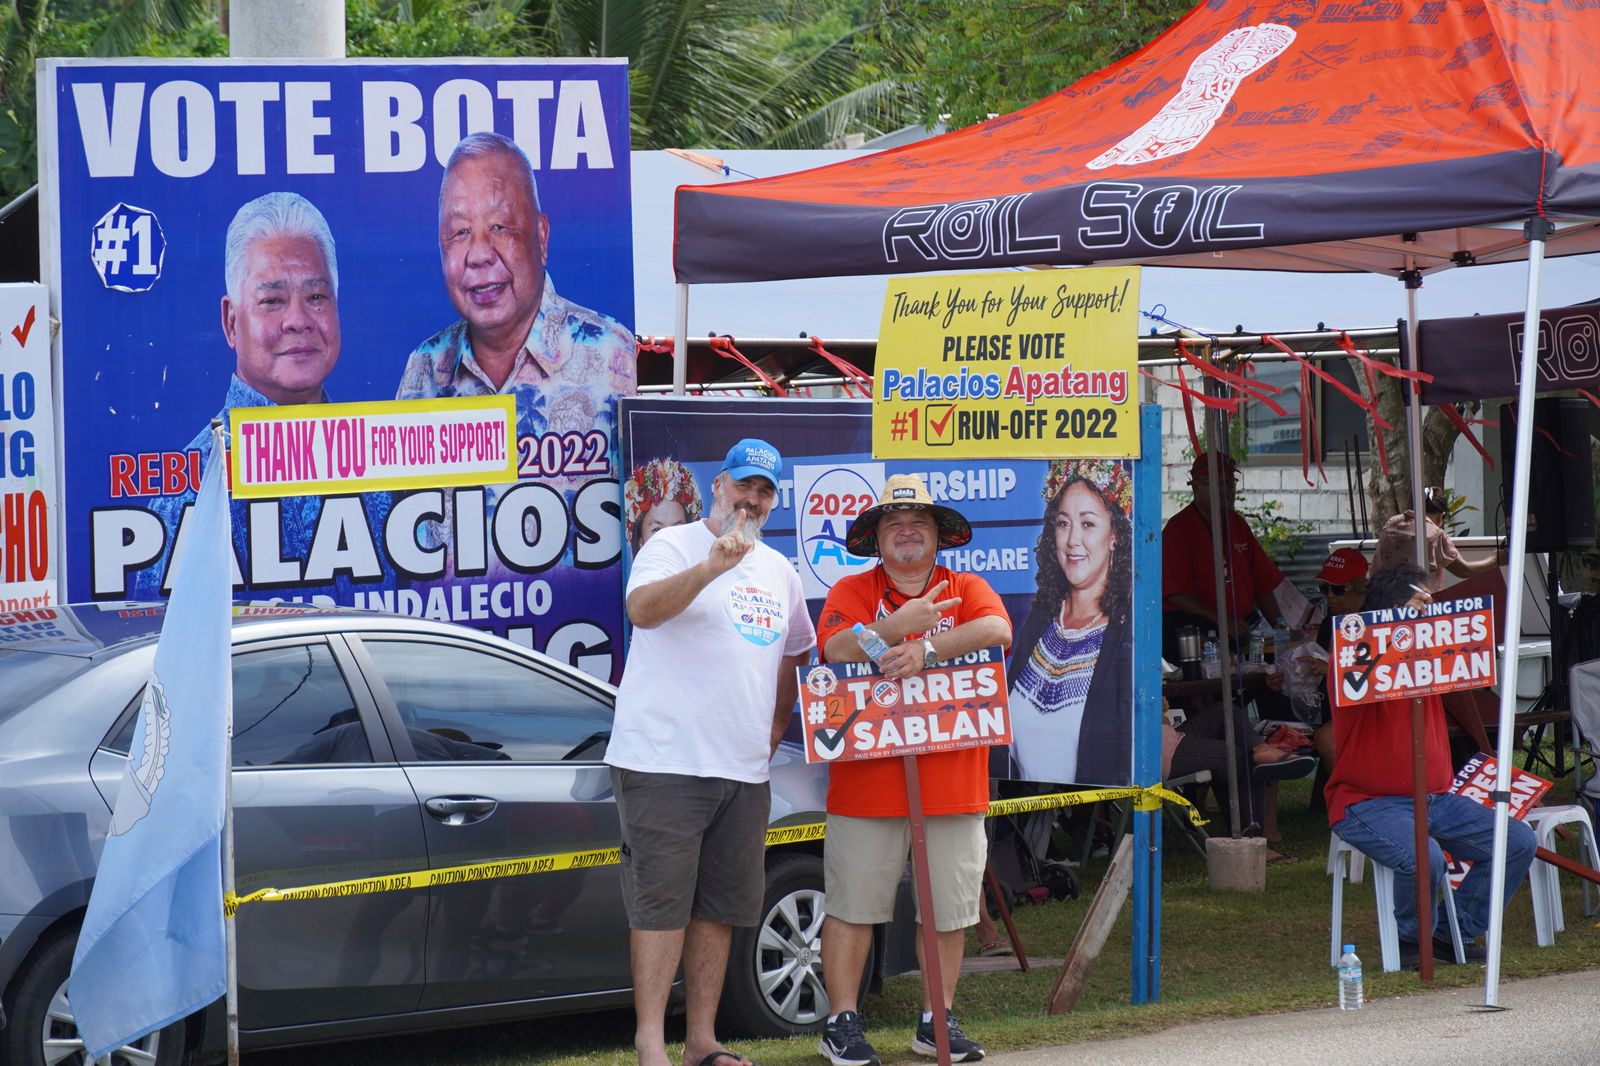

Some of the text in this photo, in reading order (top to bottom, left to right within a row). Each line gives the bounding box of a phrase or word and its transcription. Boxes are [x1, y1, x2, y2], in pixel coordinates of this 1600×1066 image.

[72, 79, 614, 178] VOTE BOTA
[95, 214, 157, 275] #1
[892, 278, 1130, 329] Thank You for Your Support!
[942, 332, 1066, 362] PLEASE VOTE
[881, 362, 1128, 406] Palacios Apatang
[891, 407, 1118, 441] #1 RUN-OFF 2022
[241, 418, 506, 483] THANK YOU FOR YOUR SUPPORT!
[517, 432, 608, 476] 2022
[745, 456, 775, 470] APATANG
[809, 494, 873, 516] 2022
[354, 580, 553, 621] INDALECIO
[1371, 597, 1484, 624] I'M VOING FOR
[1372, 614, 1488, 654] TORRES
[846, 663, 872, 677] I'M
[1374, 651, 1491, 691] SABLAN
[848, 667, 999, 711] TORRES
[854, 707, 1005, 751] SABLAN
[891, 747, 926, 755] COMMITTEE
[1458, 758, 1483, 780] FOR
[1006, 796, 1061, 813] CONSTRUCTION
[1062, 794, 1084, 807] AREA
[430, 858, 555, 886] CAUTION CONSTRUCTION AREA
[569, 851, 607, 868] CAUTION
[282, 889, 320, 900] CAUTION
[321, 880, 387, 898] CONSTRUCTION
[388, 876, 412, 890] AREA
